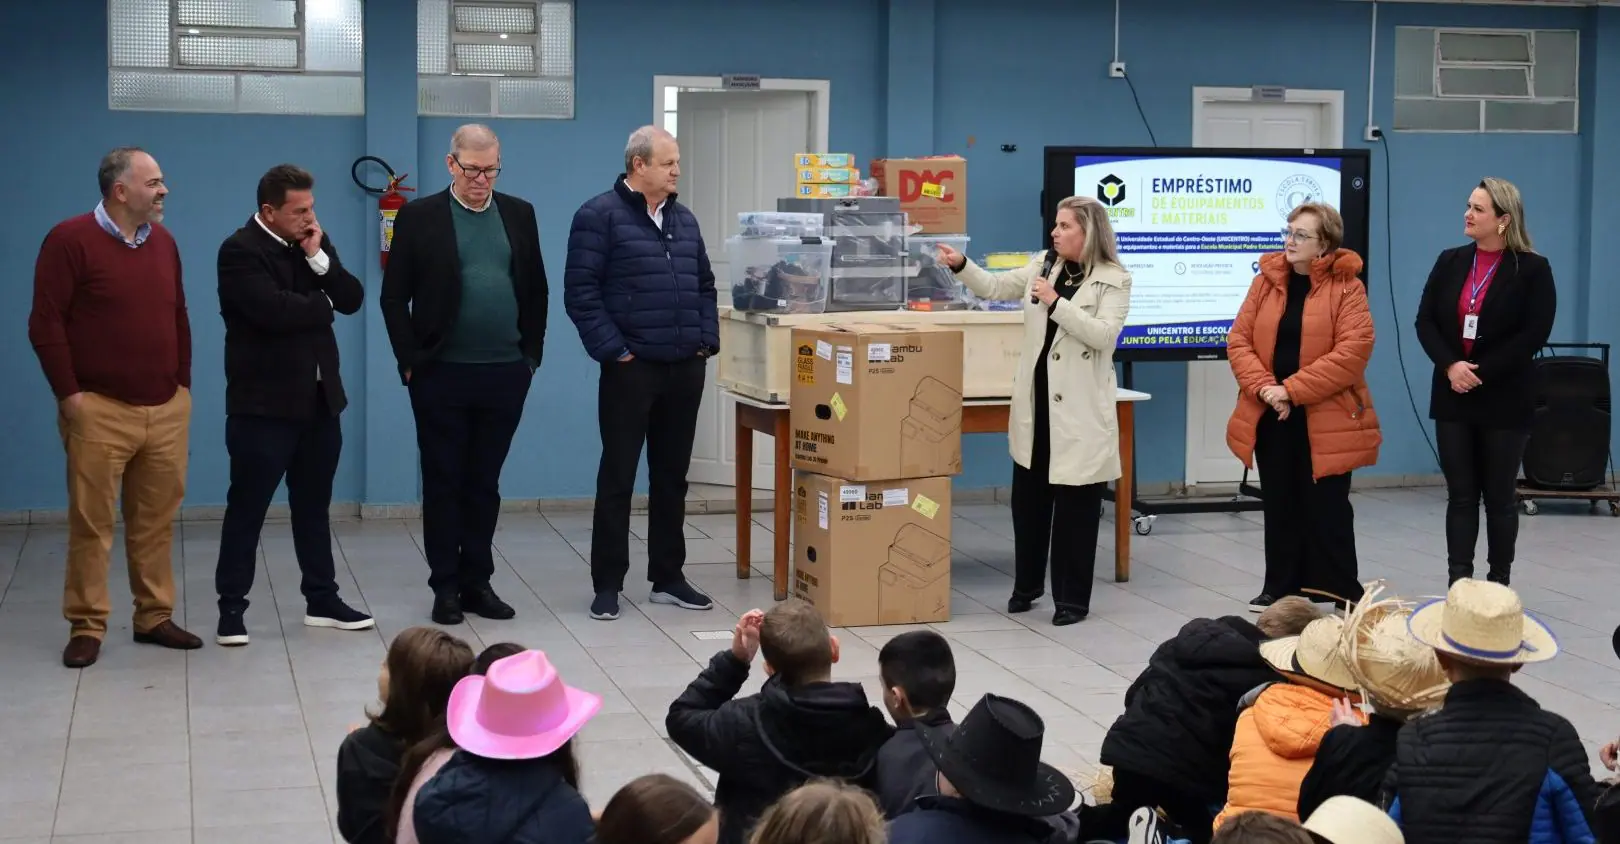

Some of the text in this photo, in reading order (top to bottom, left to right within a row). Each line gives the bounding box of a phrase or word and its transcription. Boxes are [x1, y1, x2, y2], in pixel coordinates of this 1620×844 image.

[1152, 174, 1252, 193] EMPRÉSTIMO
[1152, 197, 1264, 210] DE EQUIPAMENTOS
[1152, 213, 1227, 224] E MATERIAIS
[1147, 326, 1194, 335] UNICENTRO
[1195, 326, 1201, 335] E
[1121, 335, 1156, 344] JUNTOS
[1158, 335, 1181, 344] PELA
[891, 344, 922, 353] ambu
[811, 431, 834, 444] ANYTHING
[860, 502, 883, 510] Lab
